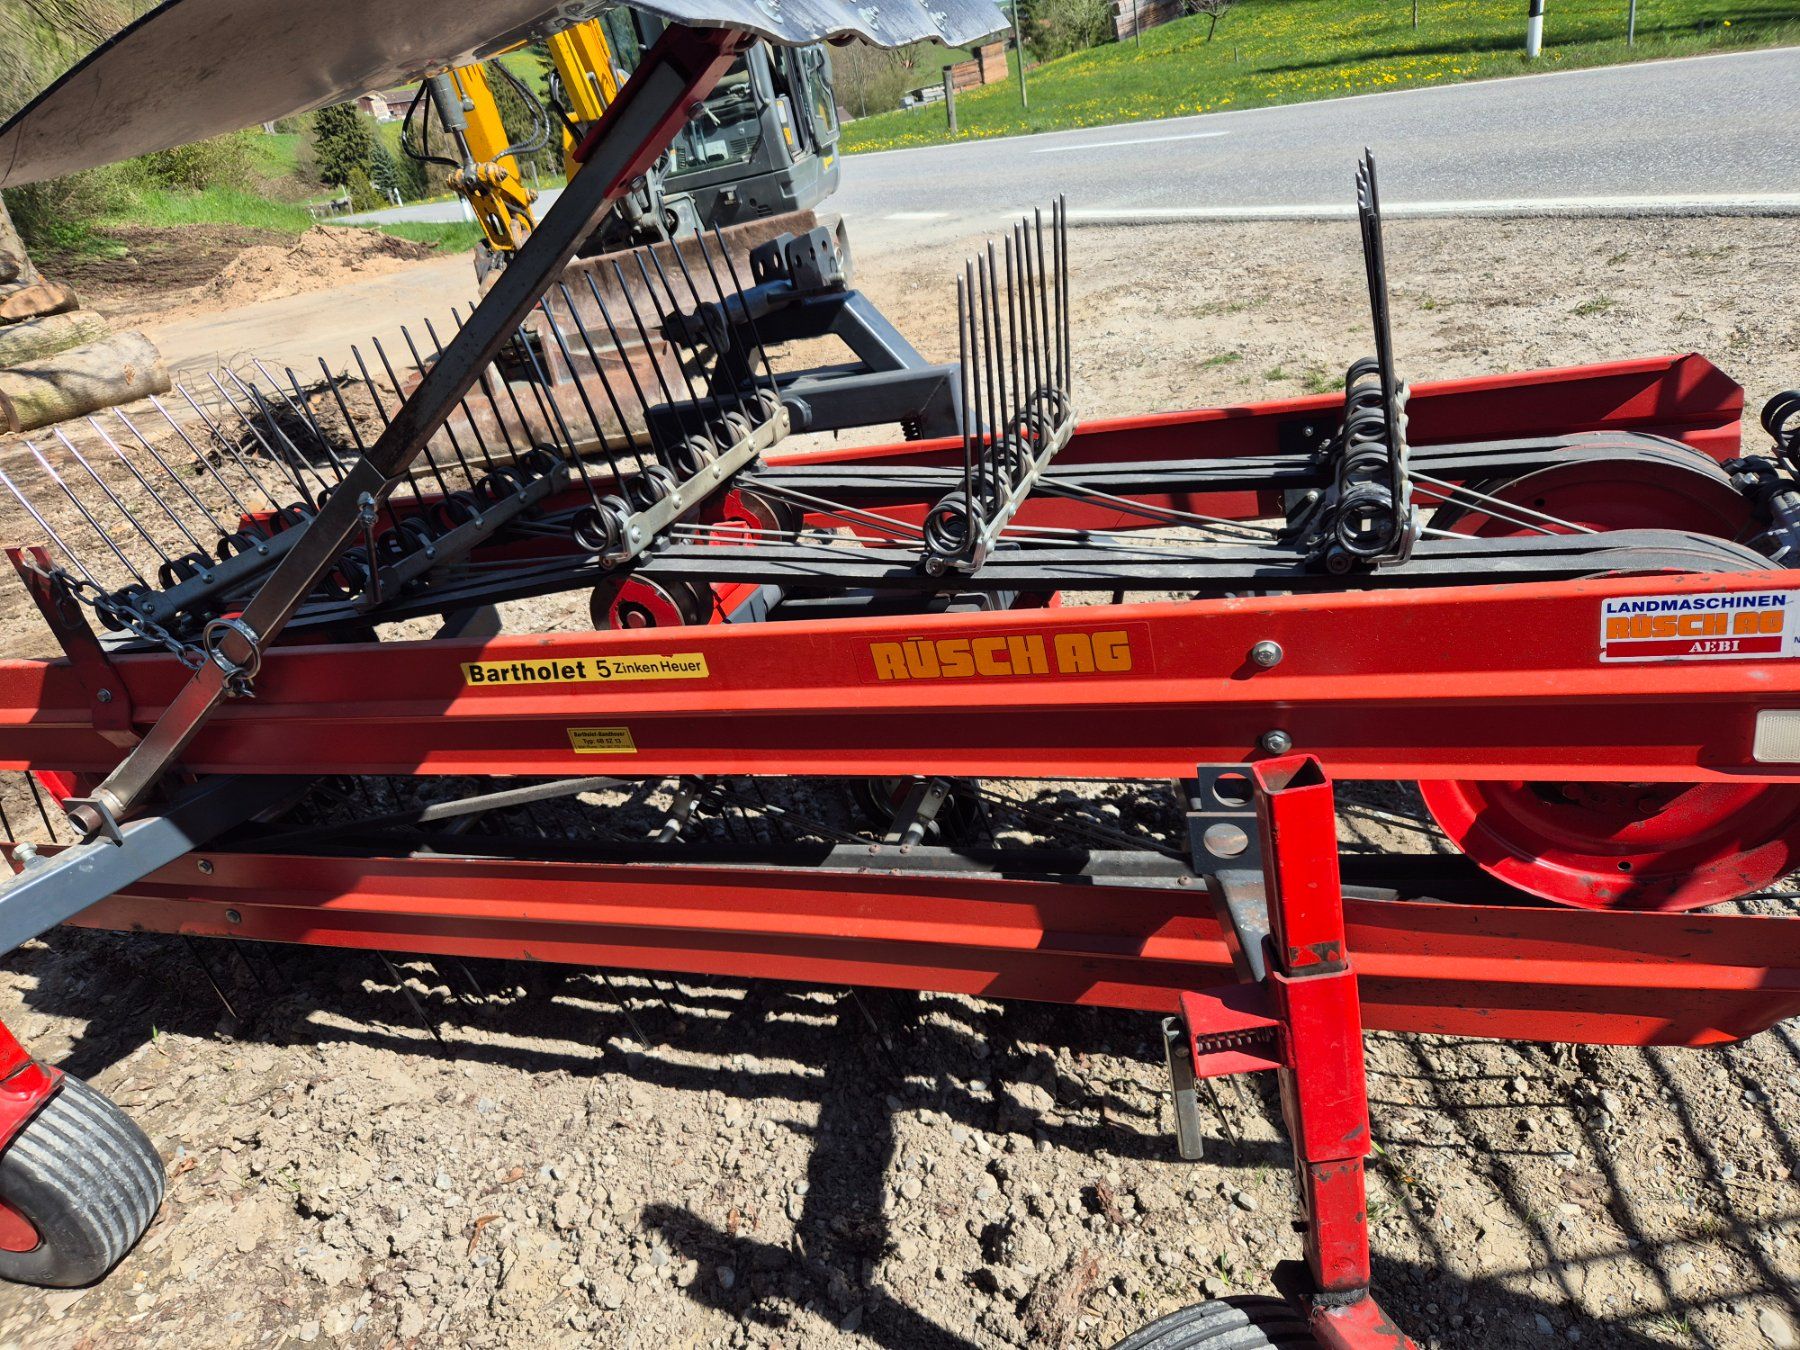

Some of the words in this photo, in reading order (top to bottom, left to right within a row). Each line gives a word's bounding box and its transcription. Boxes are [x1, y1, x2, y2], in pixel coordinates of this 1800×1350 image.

[1606, 595, 1787, 614] LANDMASCHINEN
[1606, 612, 1729, 639] RÜSCH
[1732, 610, 1785, 635] AG
[869, 636, 1050, 680] RÜSCH
[1053, 630, 1132, 673] AG
[1689, 640, 1740, 653] AEBI
[469, 661, 586, 683] Bartholet
[596, 659, 612, 678] 5
[612, 661, 659, 674] Zinken
[661, 660, 701, 673] Heuer
